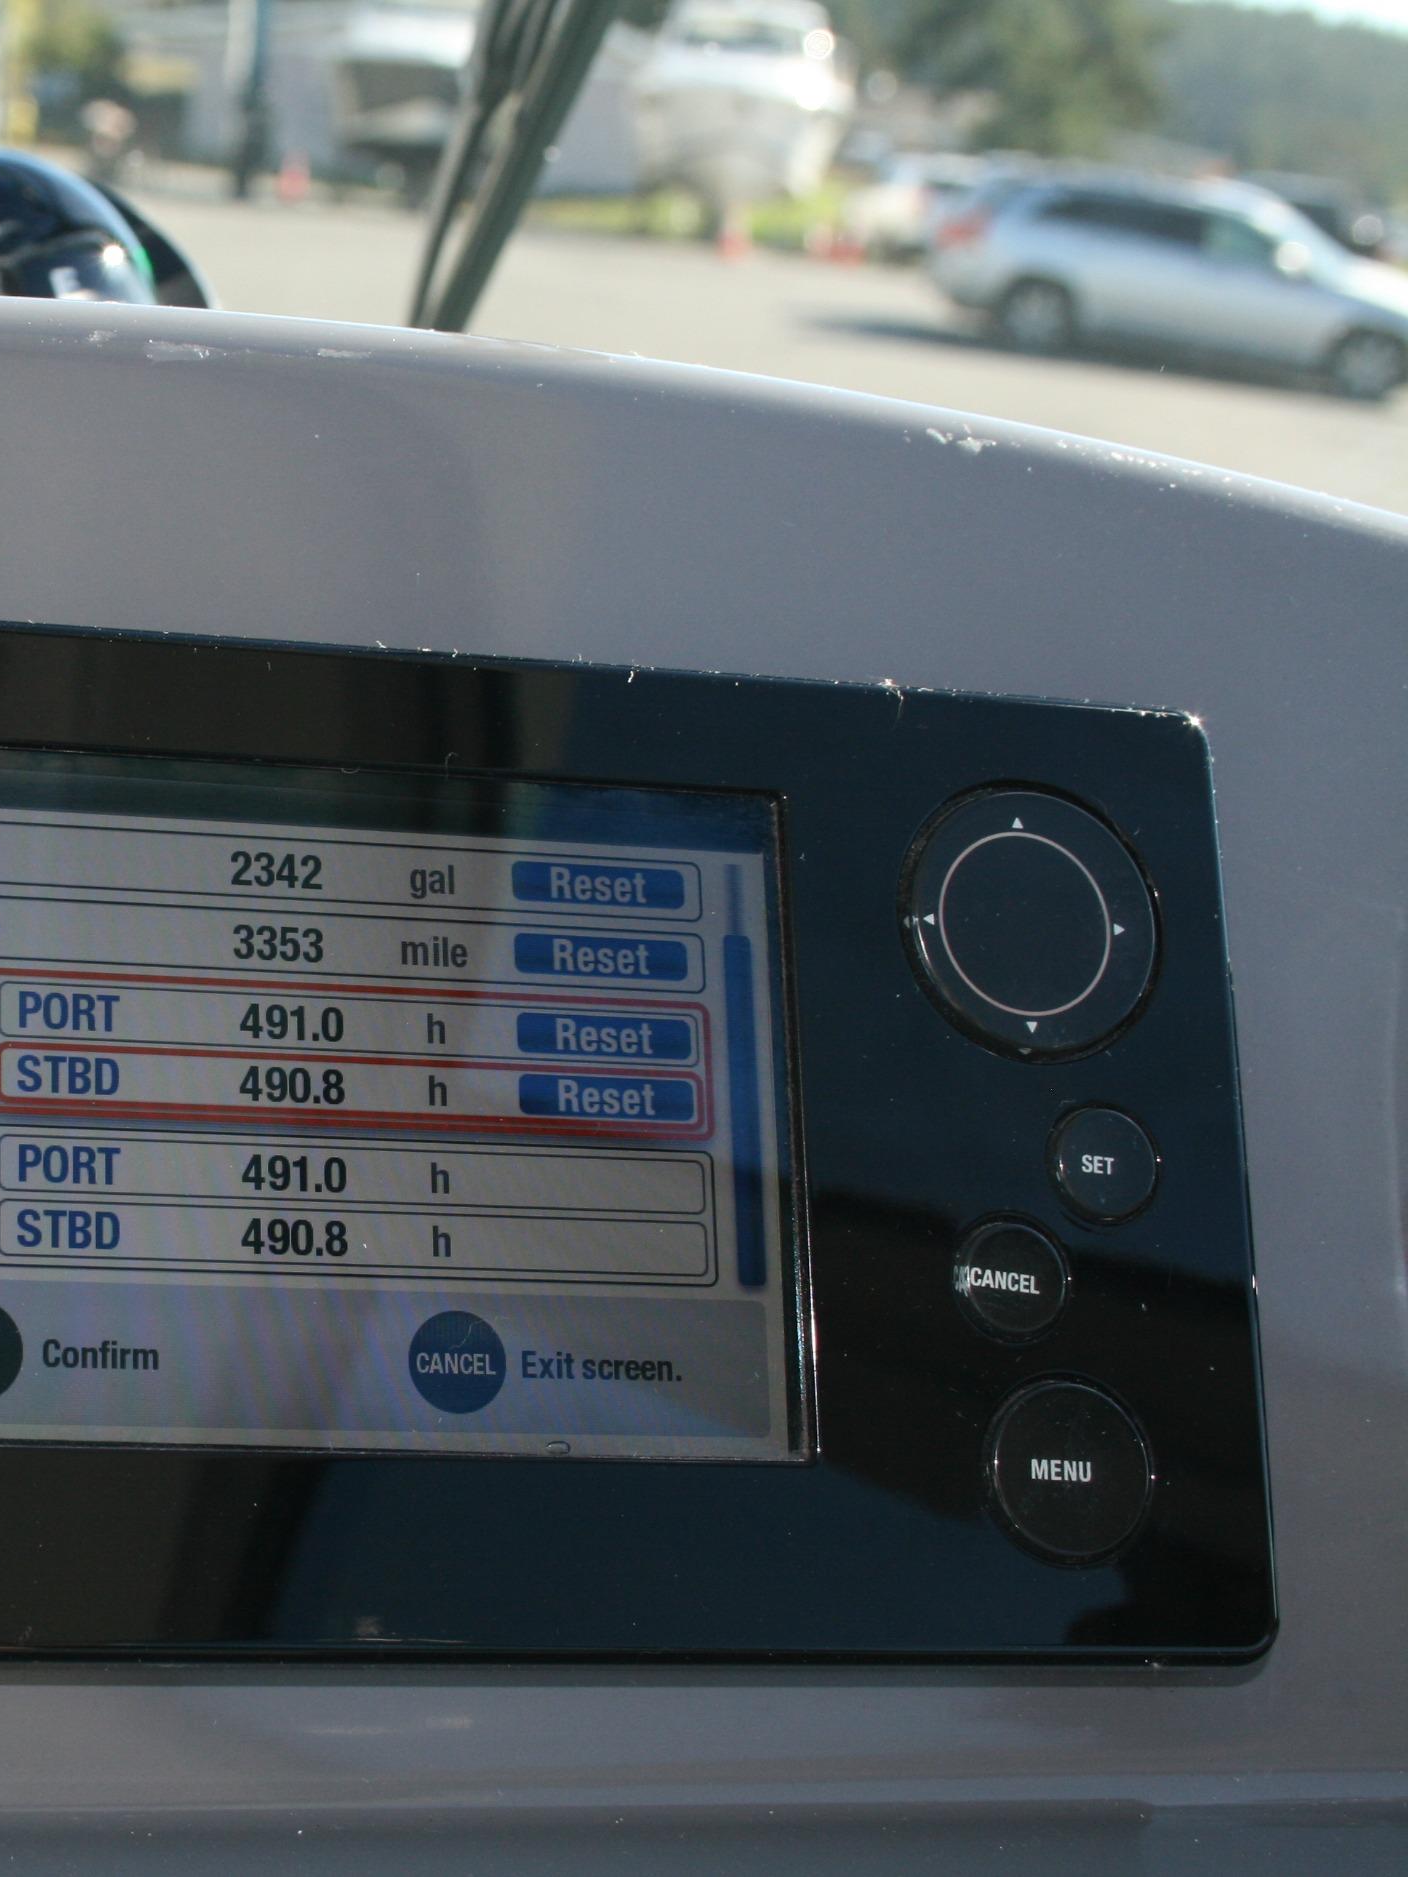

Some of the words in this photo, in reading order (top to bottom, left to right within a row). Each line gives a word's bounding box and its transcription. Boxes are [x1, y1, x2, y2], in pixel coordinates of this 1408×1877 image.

[230, 851, 323, 890] 2342
[410, 865, 455, 899] gal
[550, 866, 647, 905] Reset
[233, 924, 323, 963] 3353
[400, 937, 468, 968] mile
[552, 939, 649, 977] Reset
[18, 991, 120, 1033] PORT
[240, 1003, 344, 1043] 491.0
[427, 1013, 446, 1045] h
[555, 1018, 653, 1056] Reset
[17, 1055, 120, 1096] STBD
[240, 1066, 345, 1105] 490.8
[429, 1075, 448, 1107] h
[558, 1080, 655, 1117] Reset
[18, 1144, 121, 1185] PORT
[241, 1154, 347, 1194] 491.0
[431, 1162, 450, 1195] h
[1081, 1154, 1114, 1176] SET
[16, 1209, 120, 1250] STBD
[241, 1218, 348, 1257] 490.8
[433, 1225, 451, 1258] h
[970, 1267, 1040, 1295] CANCEL
[42, 1339, 159, 1371] Confirm
[416, 1352, 496, 1377] CANCEL
[521, 1351, 574, 1381] Exit
[582, 1355, 683, 1383] screen.
[1031, 1458, 1092, 1482] MENU
